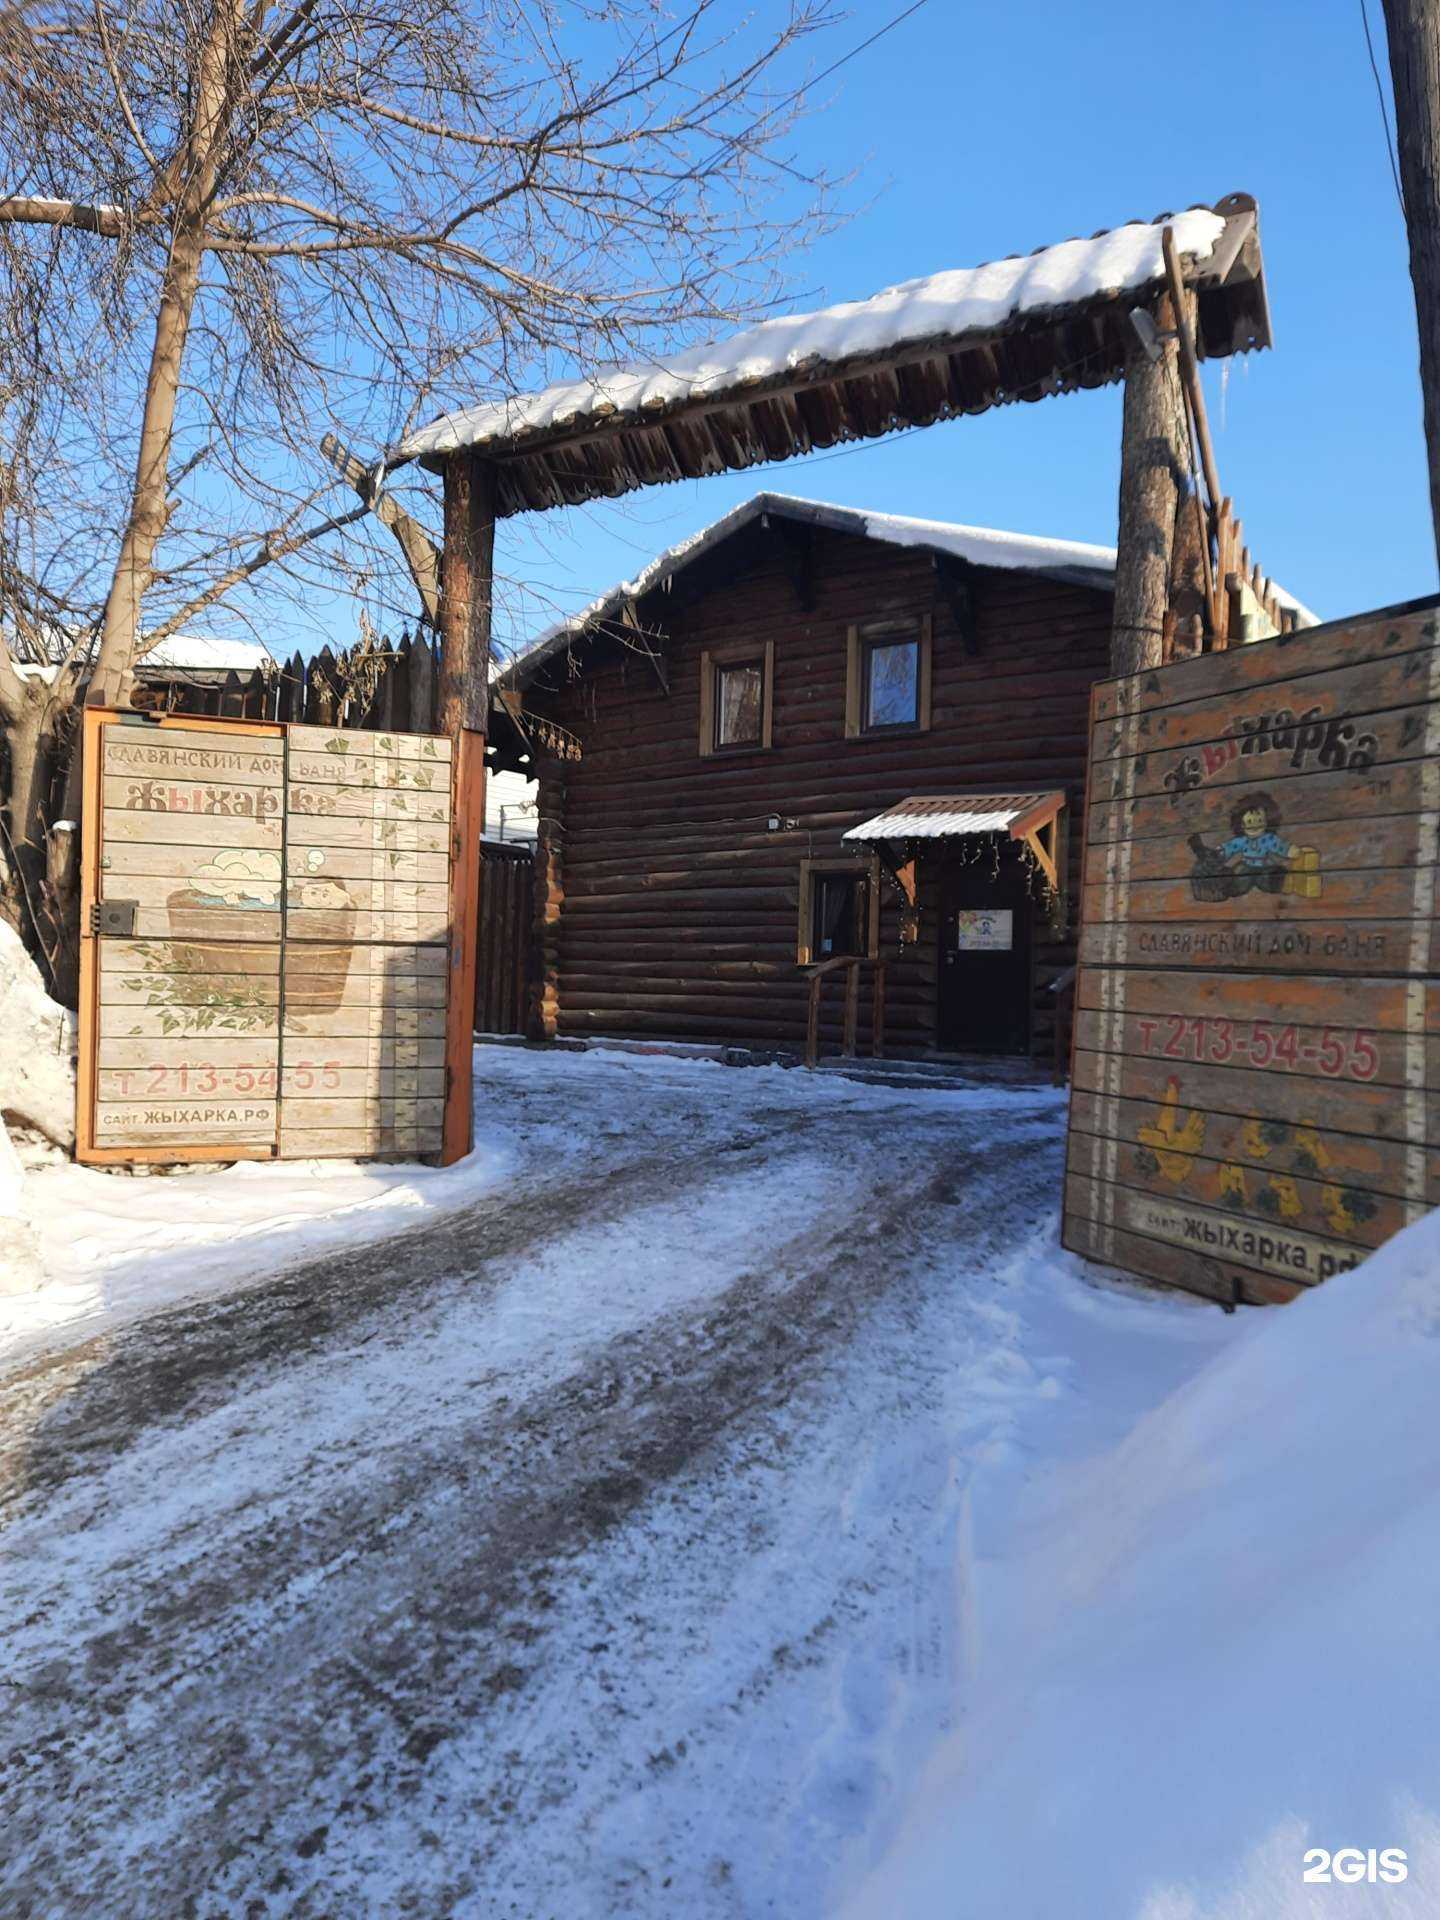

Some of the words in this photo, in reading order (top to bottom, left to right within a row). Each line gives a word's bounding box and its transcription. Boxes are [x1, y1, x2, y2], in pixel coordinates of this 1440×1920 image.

[1164, 1014, 1379, 1079] 213-54-55
[146, 1062, 342, 1094] 213-54-55
[144, 1109, 271, 1124] ЖЫХАРКА.РФ
